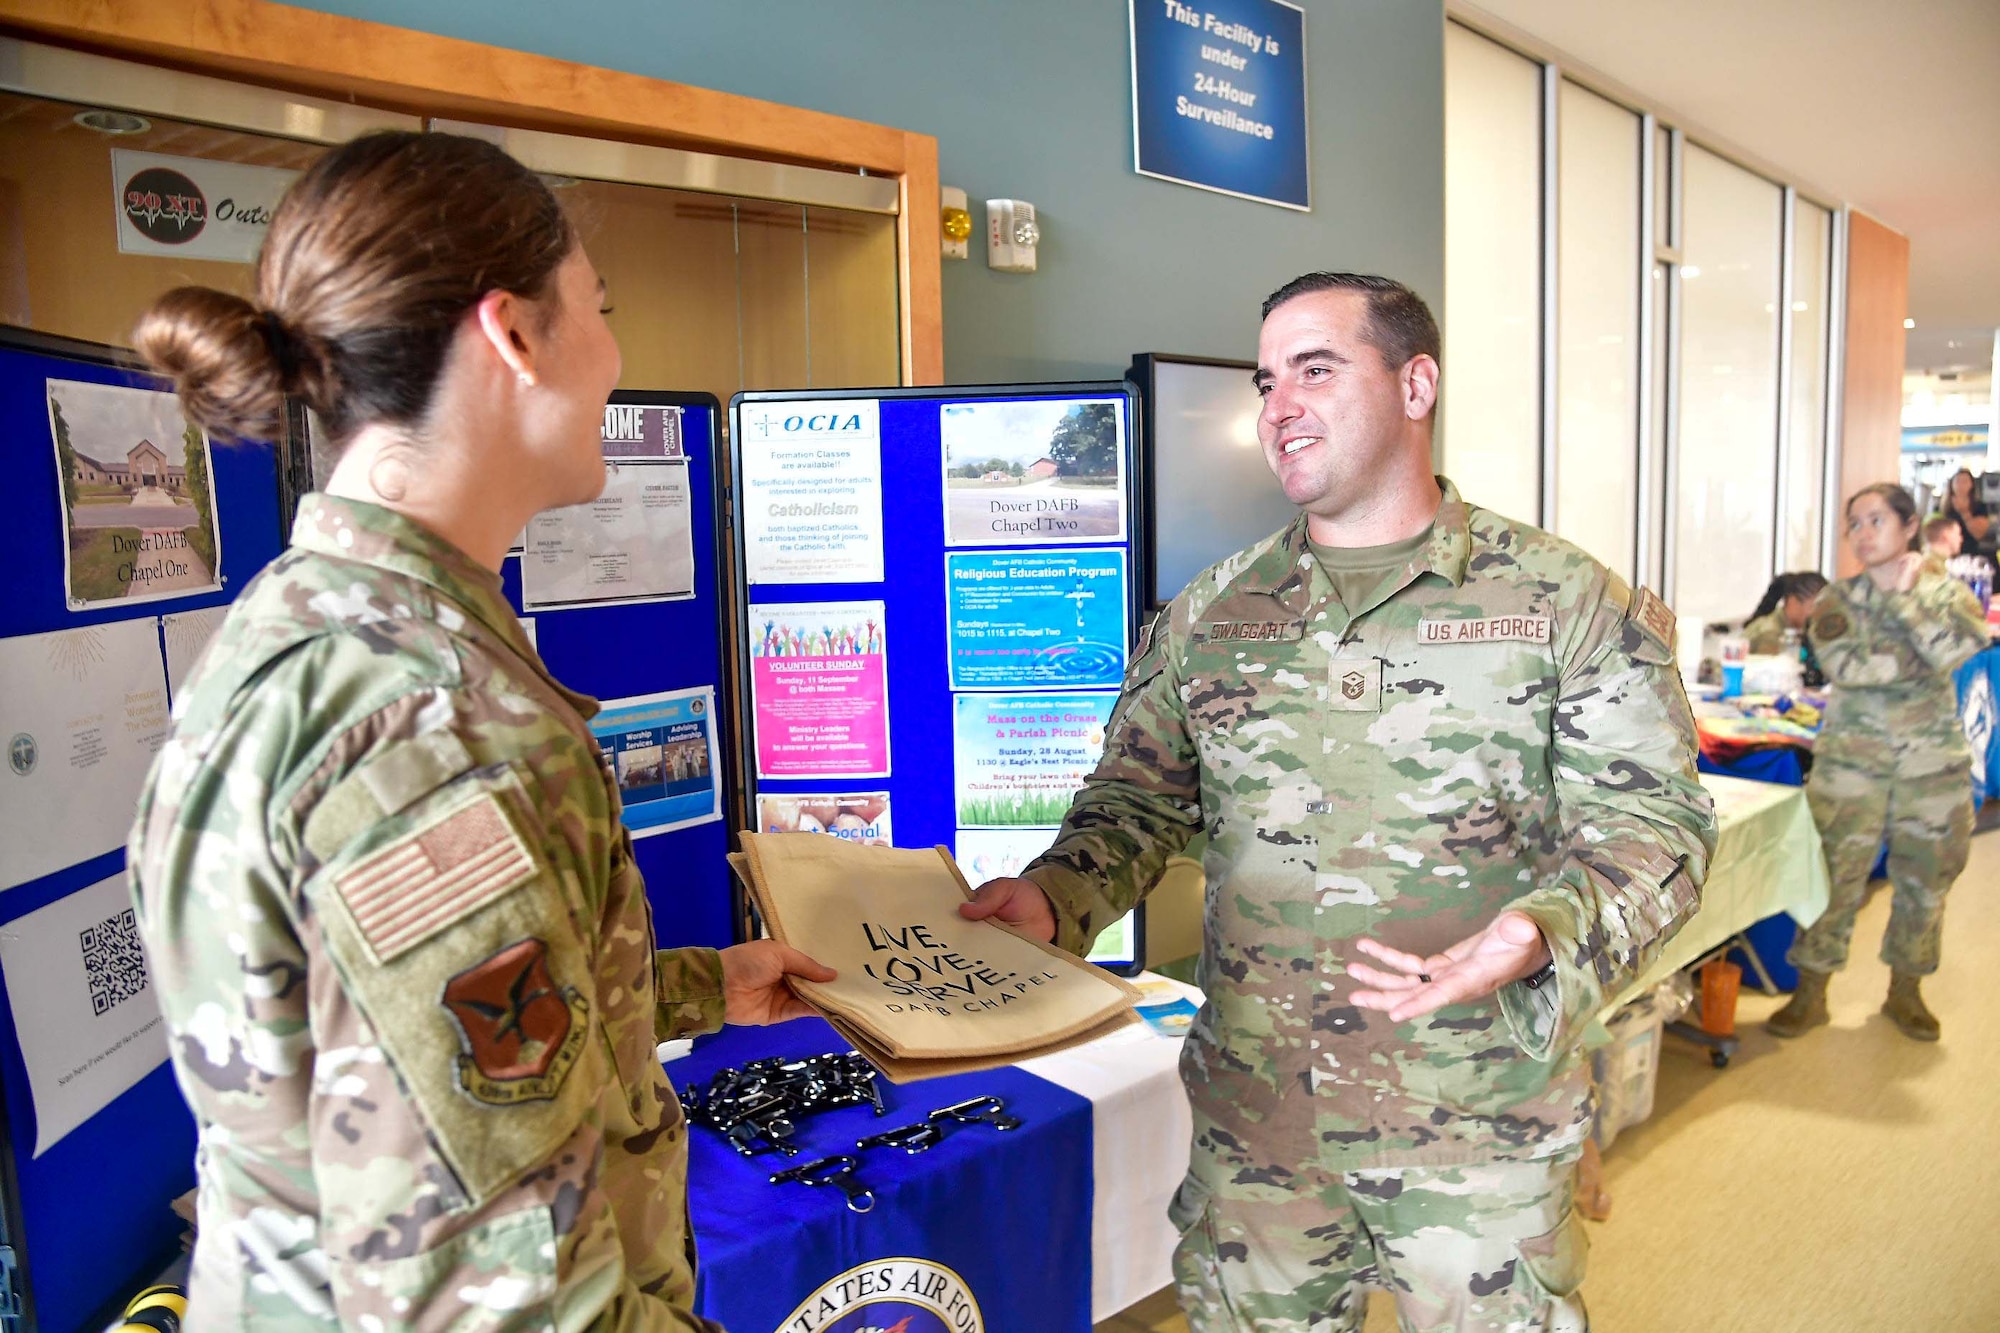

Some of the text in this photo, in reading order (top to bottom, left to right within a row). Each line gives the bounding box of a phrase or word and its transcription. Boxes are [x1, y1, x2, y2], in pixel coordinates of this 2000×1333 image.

[1164, 0, 1280, 56] This Facility is
[1201, 45, 1247, 71] under
[1194, 72, 1256, 107] 24-Hour
[1176, 95, 1274, 140] Surveillance
[128, 191, 201, 214] 90 XT
[216, 198, 272, 224] Outs
[784, 415, 861, 431] OCIA
[771, 450, 851, 459] Formation Classes
[752, 479, 795, 487] Specifically
[797, 478, 833, 486] designed
[818, 486, 855, 495] exploring
[768, 502, 859, 517] Catholicism
[990, 498, 1079, 513] Dover DAFB
[787, 525, 819, 533] baptized
[991, 518, 1078, 535] Chapel Two
[112, 531, 188, 553] Dover DAFB
[798, 534, 830, 542] thinking
[841, 533, 868, 541] joining
[118, 560, 188, 585] Chapel One
[954, 566, 1117, 580] Religious Education Program
[957, 620, 989, 629] Sundays
[1427, 619, 1545, 641] U.S. AIR FORCE
[957, 630, 976, 638] 1015
[1017, 628, 1043, 638] Chapel
[1046, 628, 1061, 636] Two
[1211, 623, 1288, 640] SWAGGART
[769, 660, 865, 671] VOLUNTEER SUNDAY
[776, 677, 805, 685] Sunday,
[818, 676, 858, 684] September
[789, 686, 797, 694] @
[1055, 701, 1095, 709] Community
[987, 715, 1017, 724] Mass
[1040, 714, 1060, 722] the
[1064, 713, 1097, 722] Grass
[671, 723, 698, 733] Advising
[789, 726, 818, 734] Ministry
[996, 728, 1088, 738] & Parish Picnic
[626, 731, 652, 741] Worship
[668, 731, 702, 743] Leadership
[626, 740, 653, 750] Services
[810, 744, 827, 752] your
[999, 748, 1036, 757] Sunday,
[1054, 747, 1086, 756] August
[1010, 758, 1038, 767] Eagle's
[1063, 757, 1088, 765] Picnic
[993, 774, 1015, 782] Bring
[1018, 774, 1036, 782] your
[828, 823, 880, 839] Social
[862, 922, 948, 952] LIVE.
[882, 967, 1016, 1001] SERVE.
[885, 970, 1058, 1017] DAFB CHAPEL
[786, 1268, 978, 1333] TATES AIR FOR
